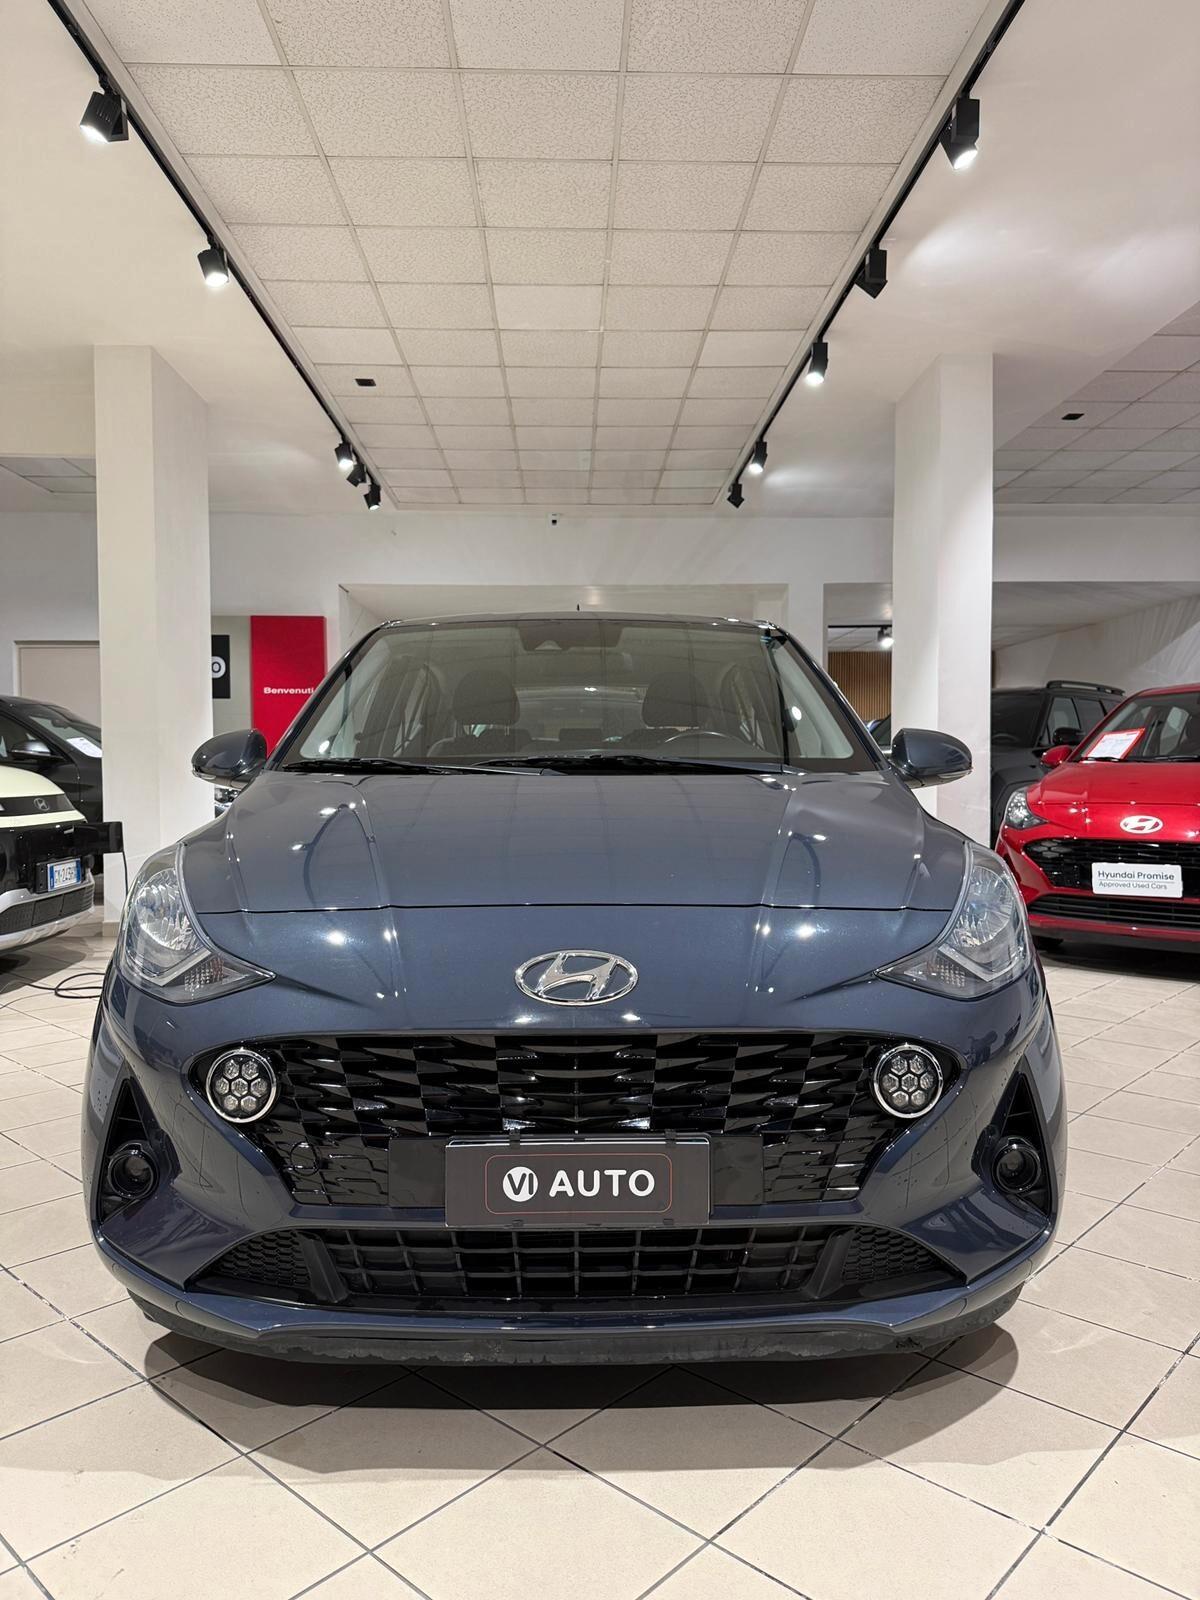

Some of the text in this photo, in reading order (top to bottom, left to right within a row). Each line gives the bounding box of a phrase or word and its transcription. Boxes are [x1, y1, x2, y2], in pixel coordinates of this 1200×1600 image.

[1098, 870, 1175, 880] Hyundai Promise
[1099, 881, 1131, 889] Approved
[549, 1169, 655, 1197] AUTO
